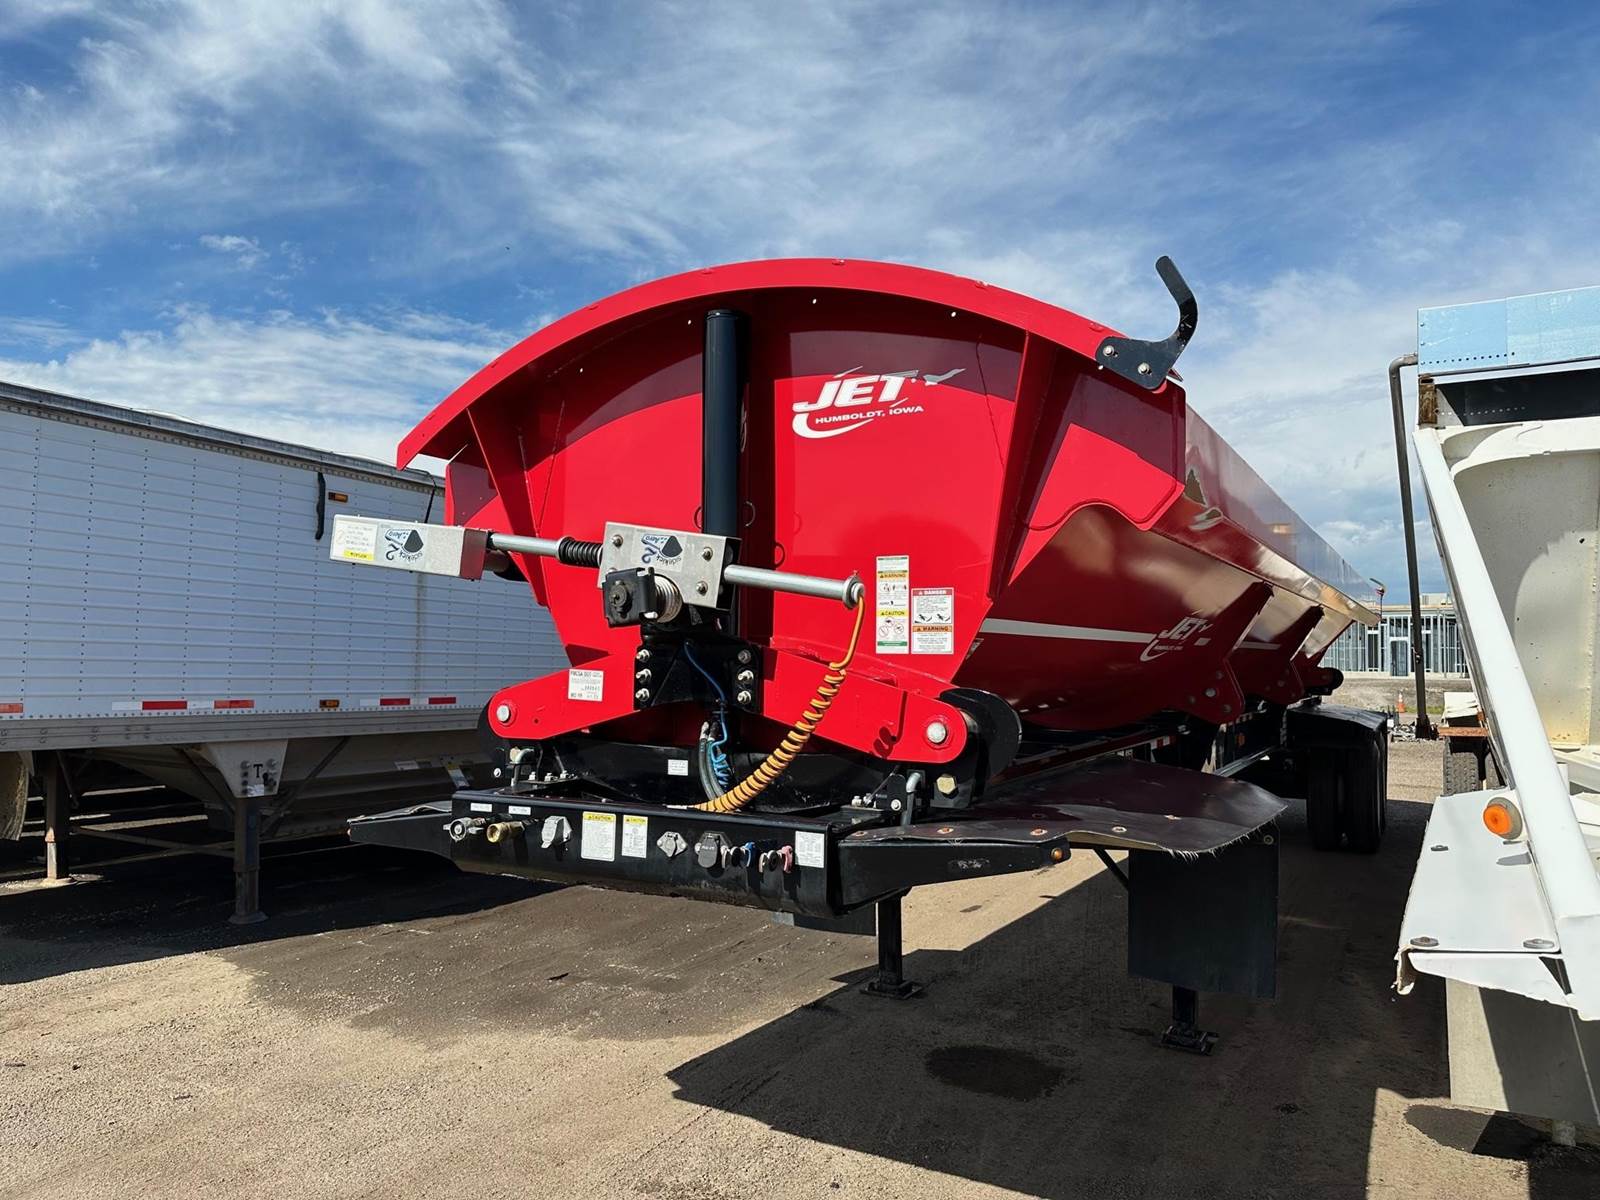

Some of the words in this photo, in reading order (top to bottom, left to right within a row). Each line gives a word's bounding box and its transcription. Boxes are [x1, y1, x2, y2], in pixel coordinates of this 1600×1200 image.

[792, 374, 906, 413] JET
[815, 410, 885, 424] HUMBOLDT,
[889, 406, 924, 416] IOWA
[385, 543, 400, 561] 2
[641, 547, 657, 564] 2
[1157, 617, 1209, 640] JET
[253, 763, 264, 778] T
